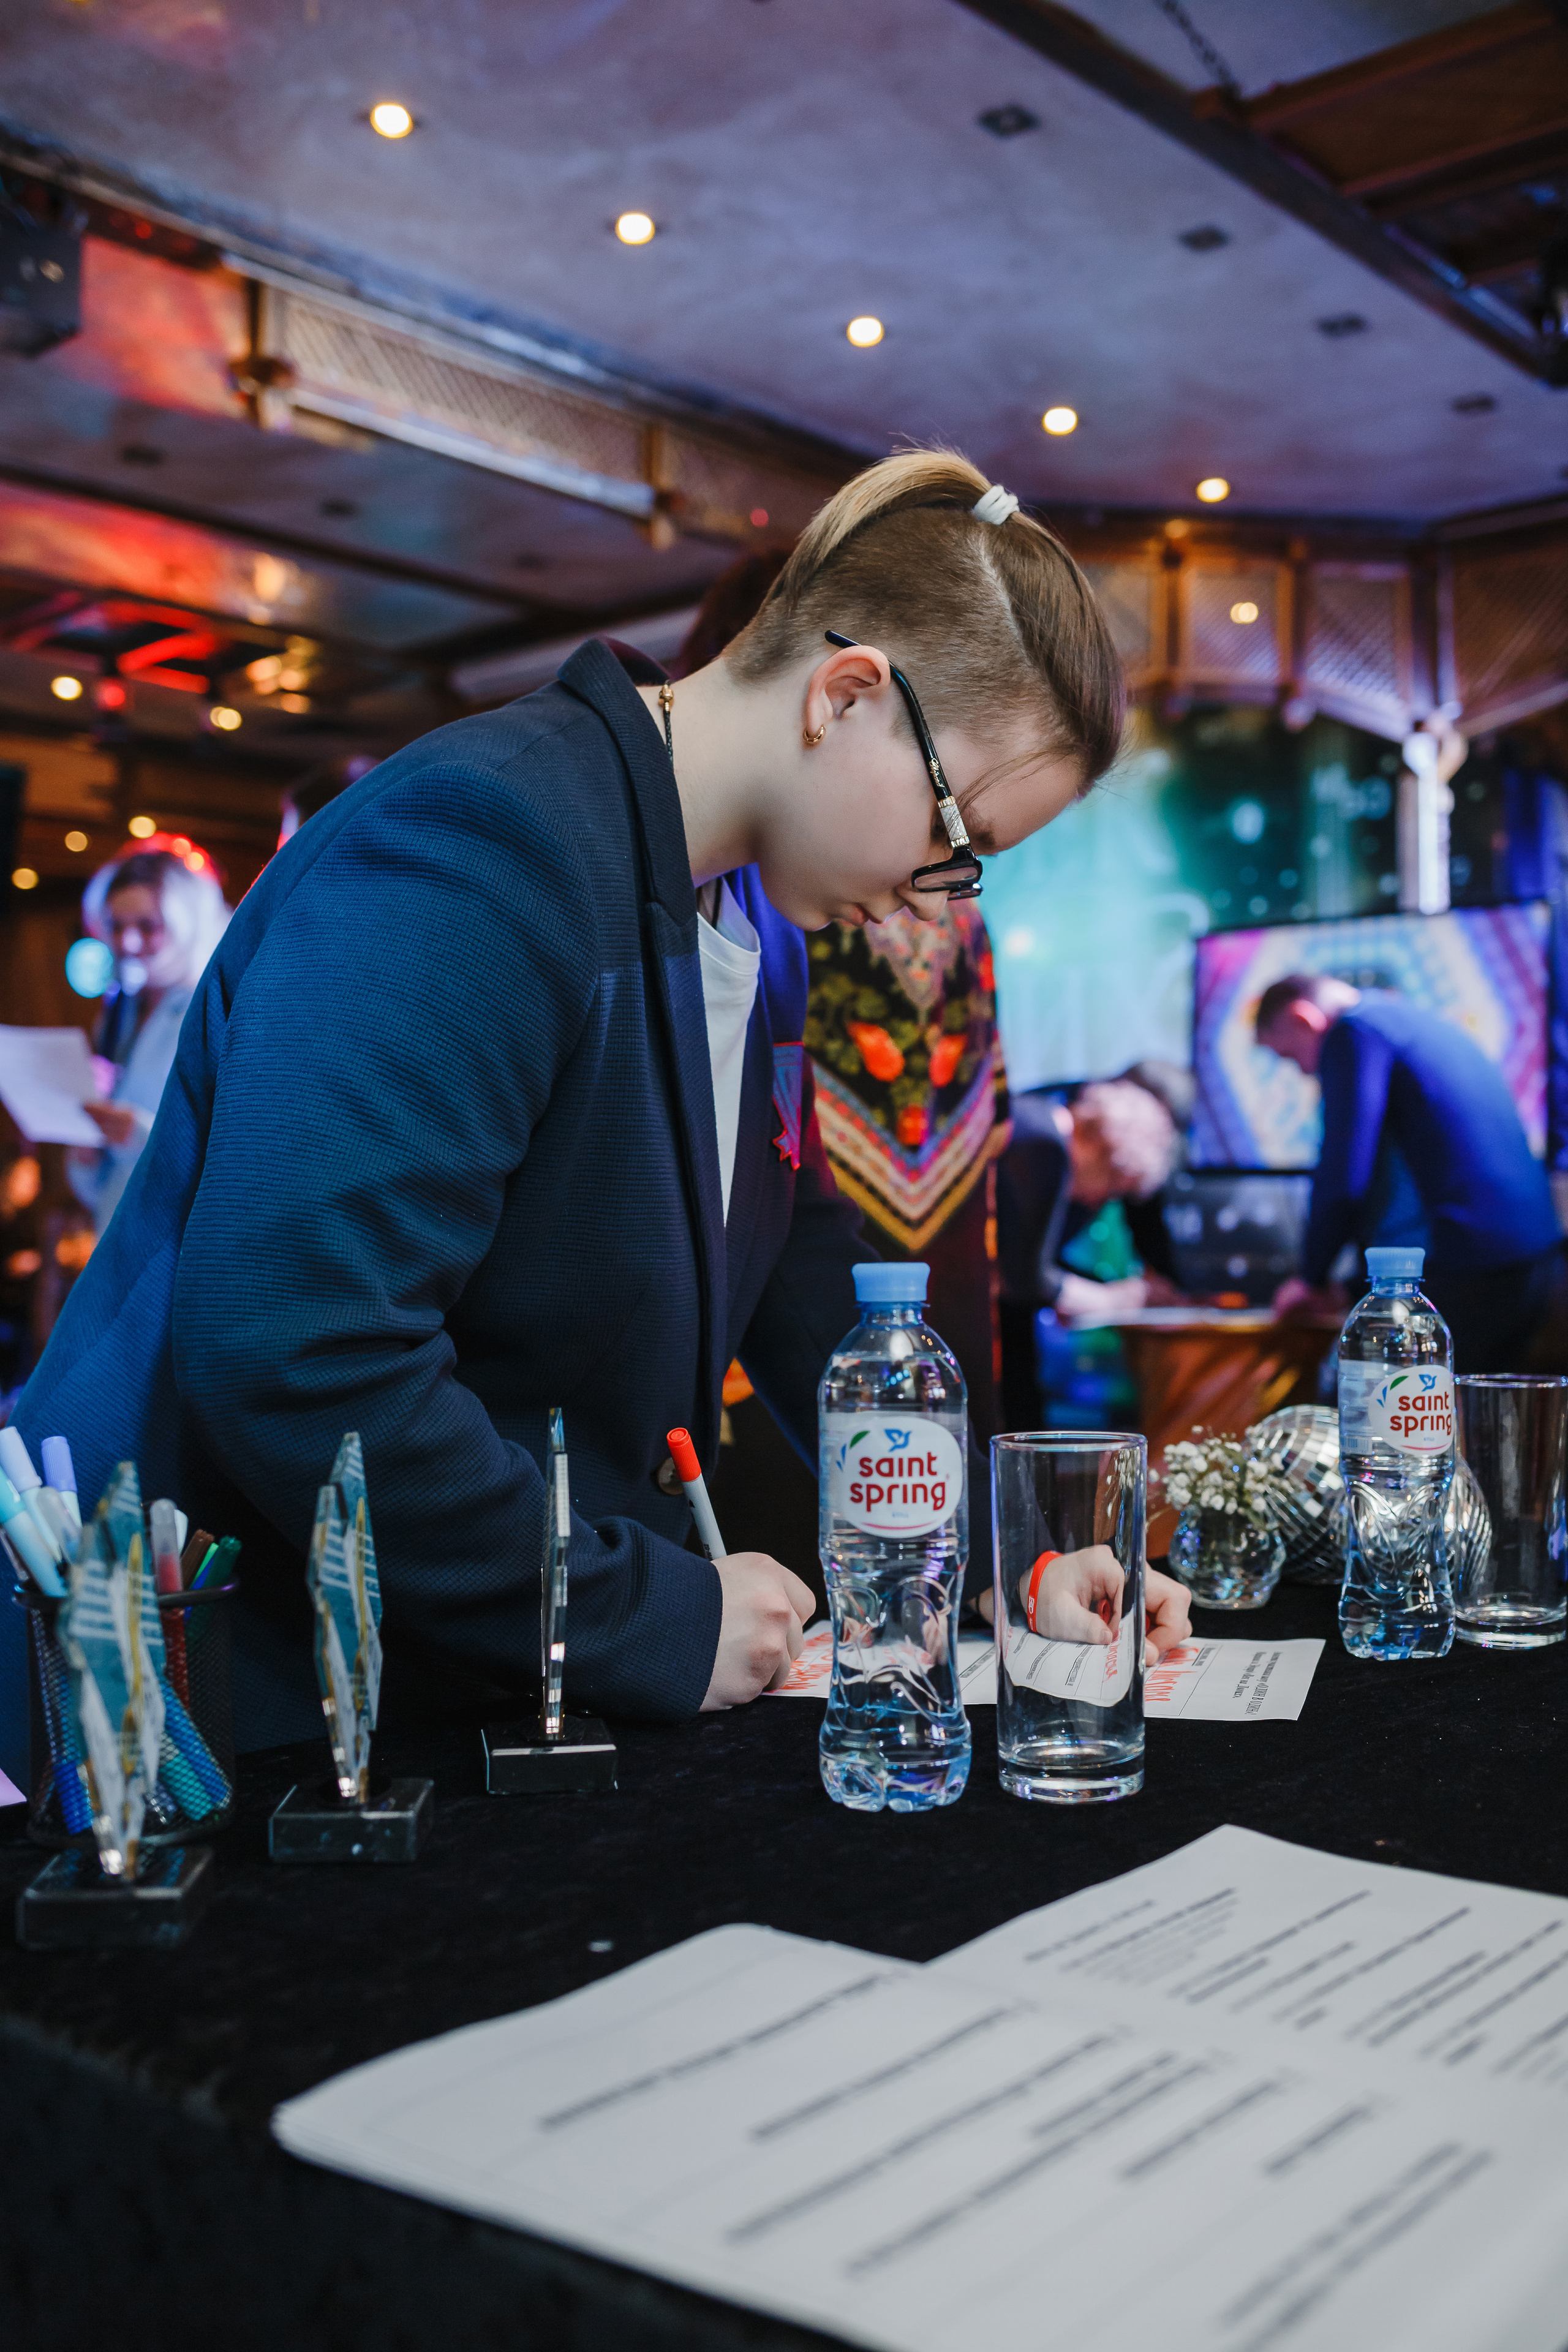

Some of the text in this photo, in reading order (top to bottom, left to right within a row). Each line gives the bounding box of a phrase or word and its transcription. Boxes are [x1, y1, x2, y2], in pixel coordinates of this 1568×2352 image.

[1398, 1391, 1449, 1411] saint
[1390, 1414, 1452, 1438] spring
[859, 1451, 937, 1477] saint
[850, 1482, 946, 1512] spring
